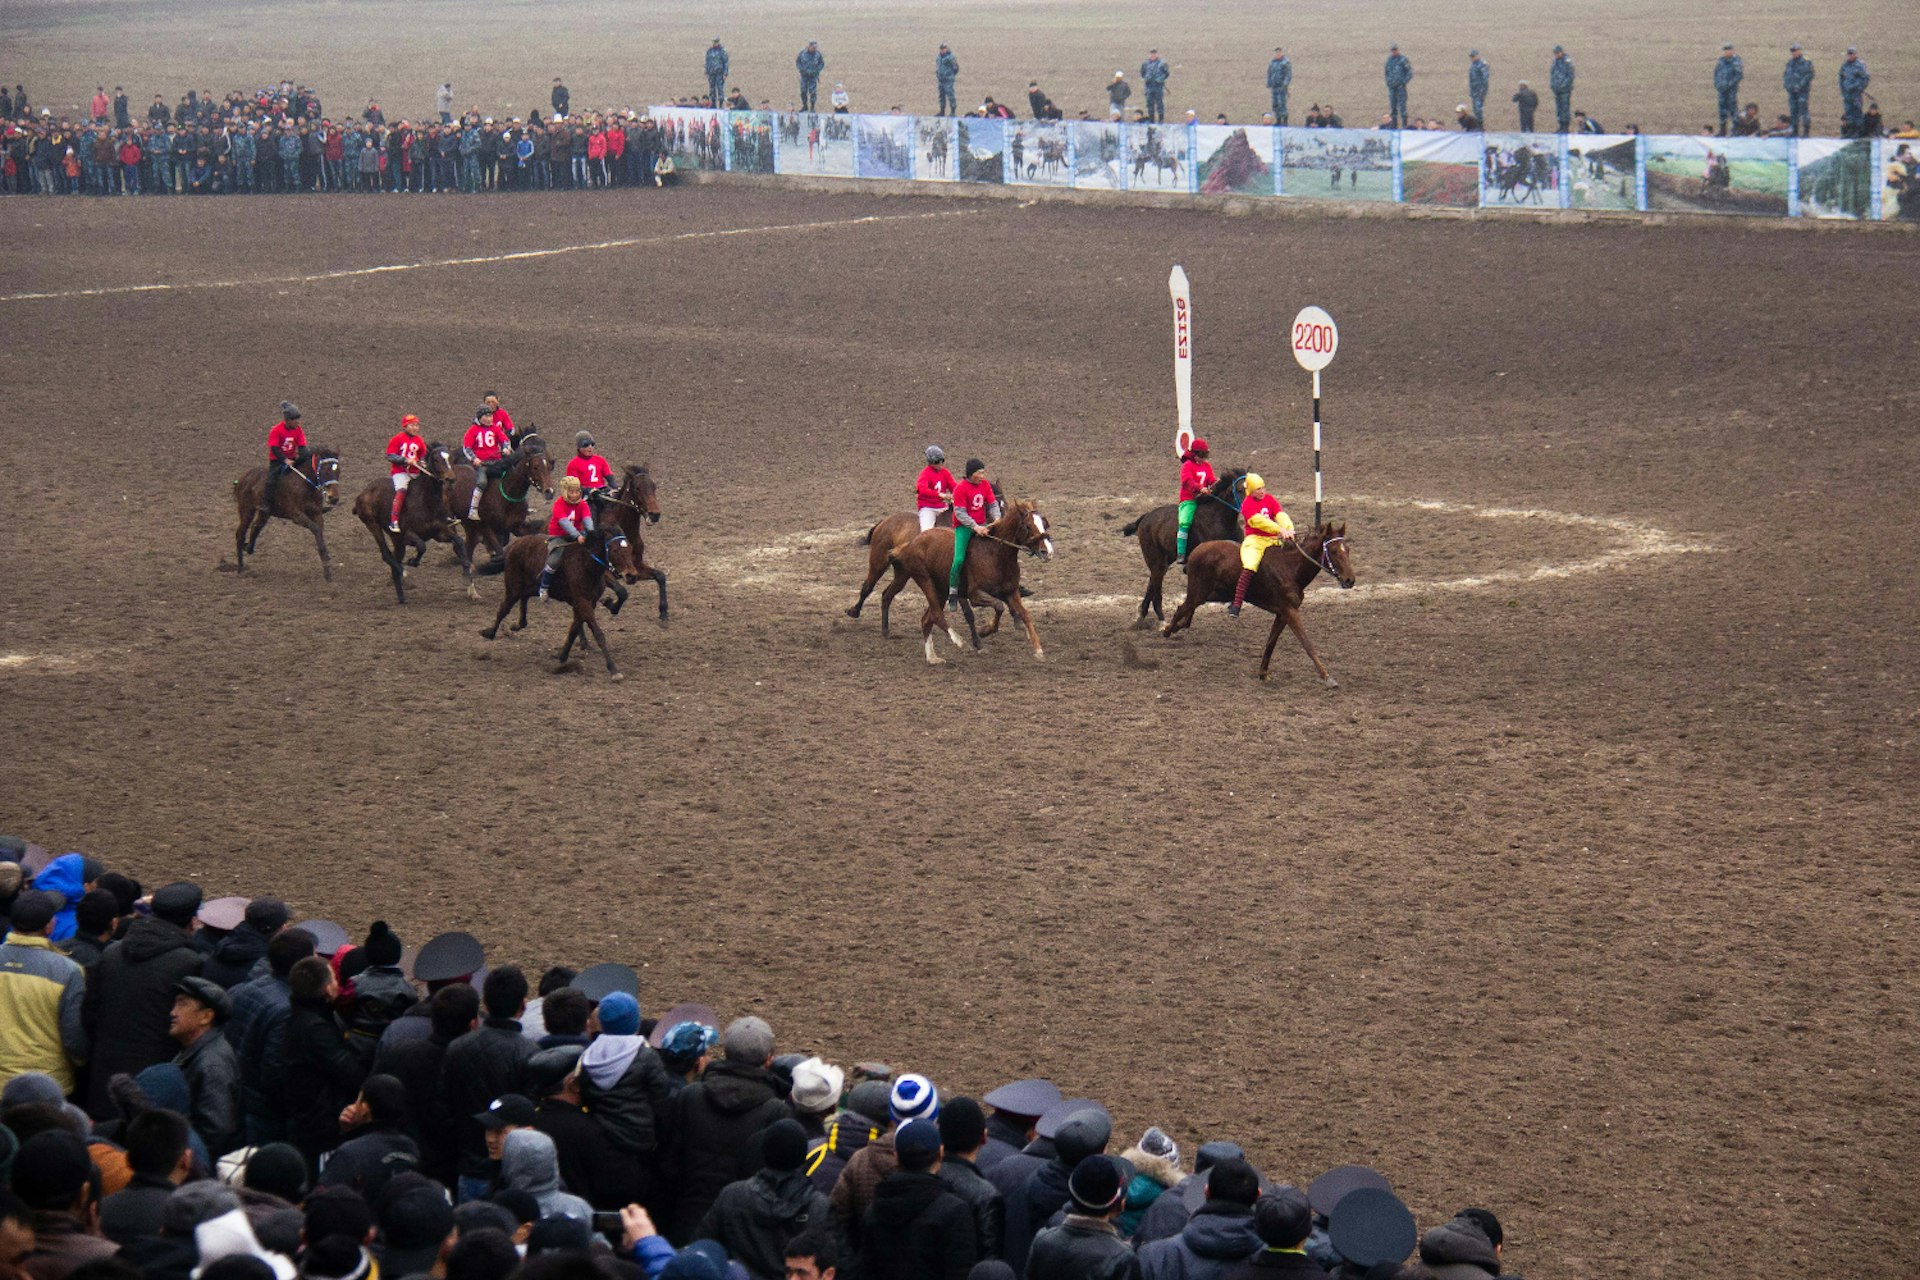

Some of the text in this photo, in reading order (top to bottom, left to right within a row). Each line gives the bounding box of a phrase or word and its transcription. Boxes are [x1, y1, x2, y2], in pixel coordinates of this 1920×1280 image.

[1295, 323, 1333, 353] 2200
[281, 437, 294, 451] 5
[476, 430, 495, 448] 16
[400, 442, 419, 459] 18
[588, 464, 599, 482] 2
[1196, 471, 1207, 485] 7
[971, 493, 984, 510] 9
